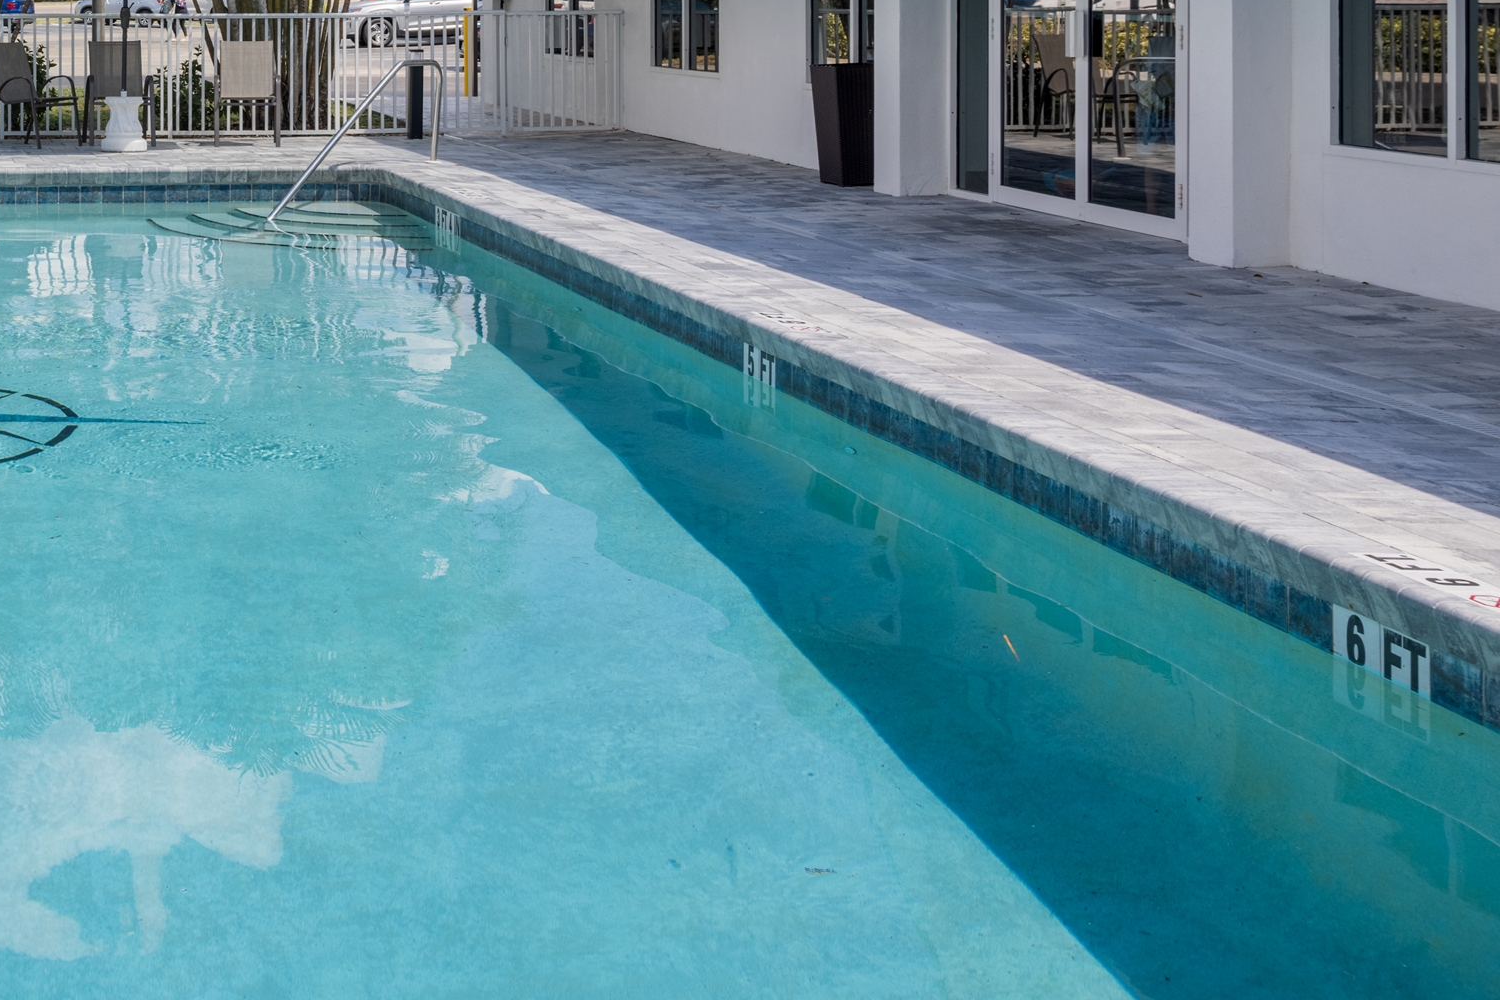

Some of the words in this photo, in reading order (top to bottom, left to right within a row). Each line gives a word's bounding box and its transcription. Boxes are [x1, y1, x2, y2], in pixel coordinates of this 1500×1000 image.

[747, 344, 754, 377] 5
[760, 350, 775, 386] FT
[1425, 576, 1480, 587] 6
[1346, 614, 1366, 666] 6
[1383, 627, 1427, 693] FT
